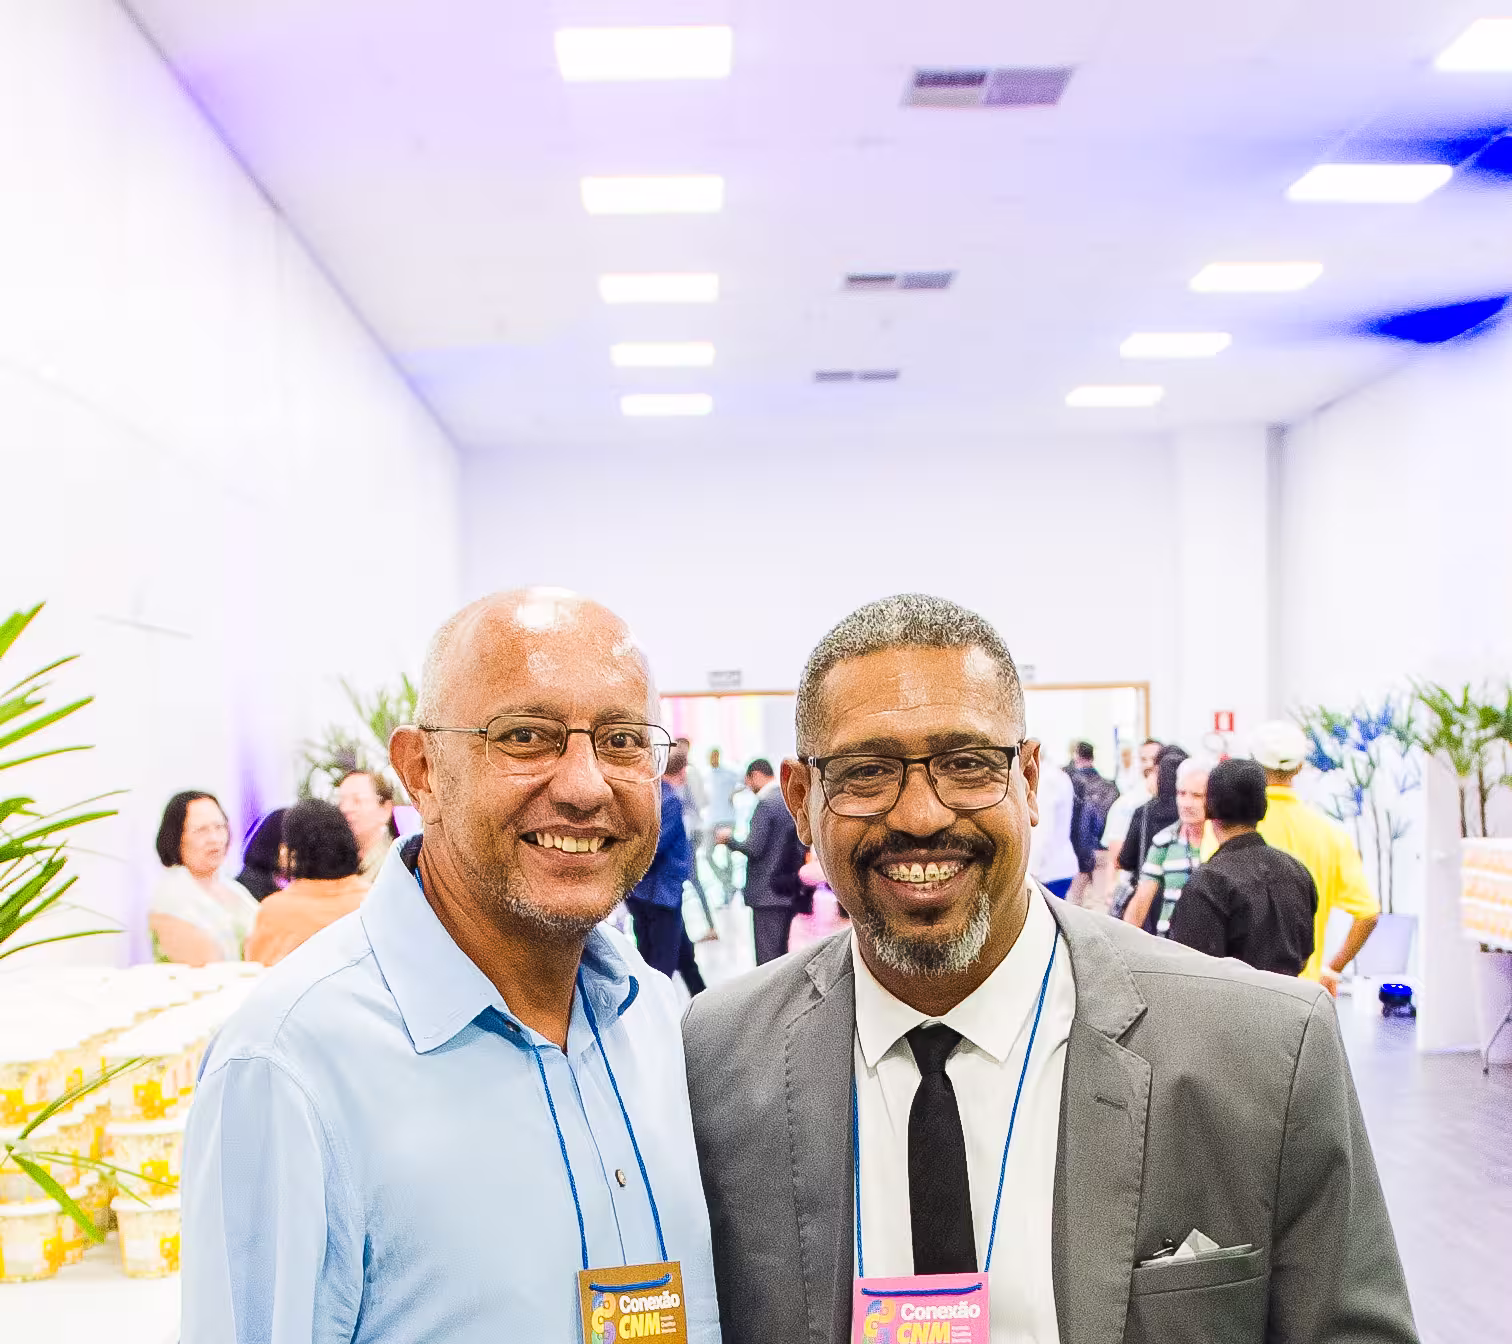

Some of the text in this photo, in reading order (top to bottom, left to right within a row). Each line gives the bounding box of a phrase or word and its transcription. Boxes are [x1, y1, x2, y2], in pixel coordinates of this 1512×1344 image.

[619, 1290, 680, 1313] Conexão
[900, 1301, 980, 1320] Conexão
[619, 1312, 660, 1339] CNM
[897, 1321, 951, 1344] CNM
